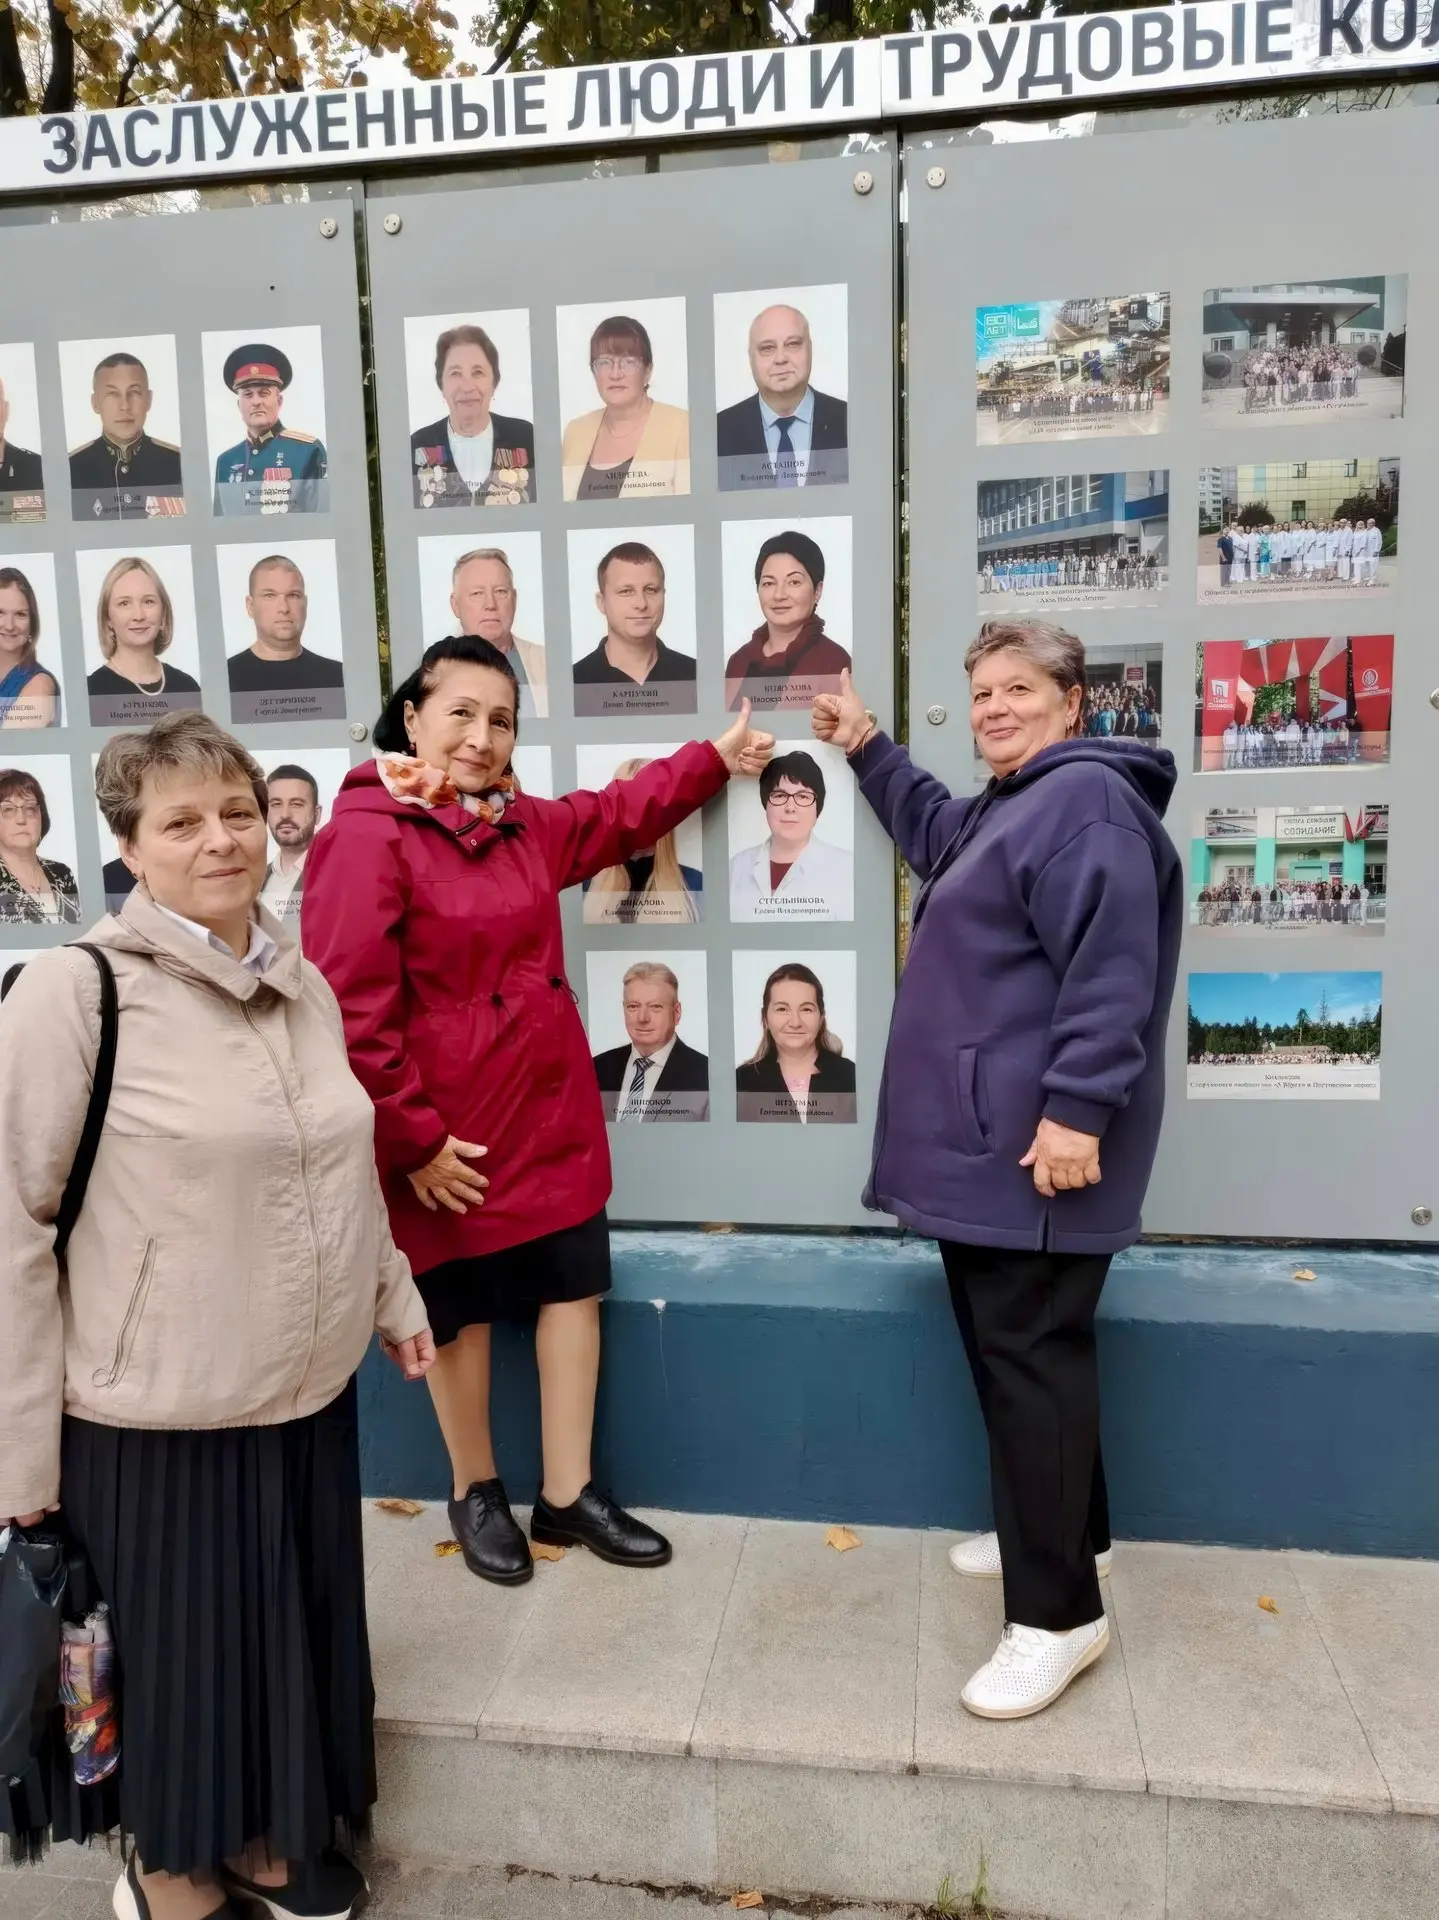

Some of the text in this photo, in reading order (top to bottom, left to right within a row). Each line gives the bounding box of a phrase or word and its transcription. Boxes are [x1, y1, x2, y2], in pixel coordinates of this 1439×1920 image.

[44, 77, 547, 173] ЗАСЛУЖЕННЫЕ
[568, 50, 787, 130] ЛЮДИ
[810, 46, 855, 110] И
[885, 0, 1293, 98] ТРУДОВЫЕ
